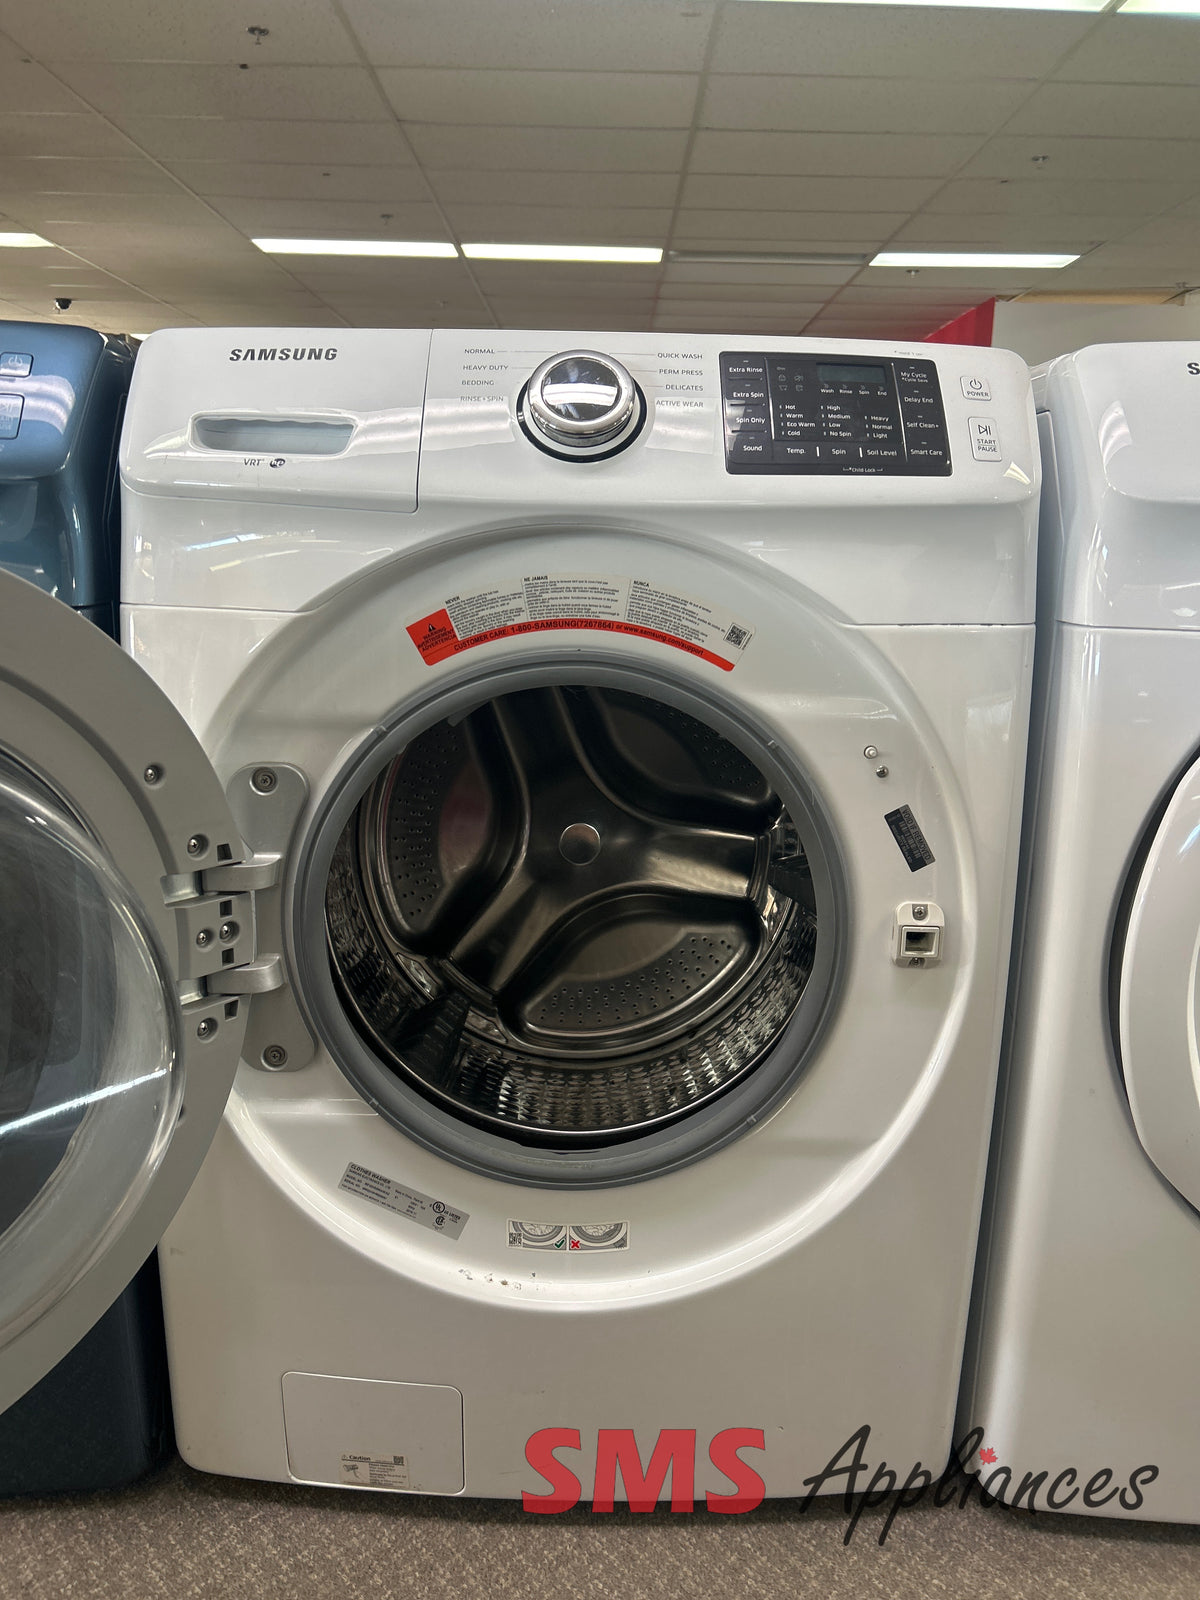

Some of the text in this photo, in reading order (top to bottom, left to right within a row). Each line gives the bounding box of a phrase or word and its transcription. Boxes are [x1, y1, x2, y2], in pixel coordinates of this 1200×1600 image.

[230, 348, 338, 361] SAMSUNG
[751, 391, 764, 399] Spin
[904, 396, 921, 404] Delay
[831, 448, 847, 456] Spin
[454, 634, 489, 651] CUSTOMER
[902, 810, 913, 825] VOID
[913, 832, 932, 860] REMOVED
[371, 1171, 391, 1184] WASHER
